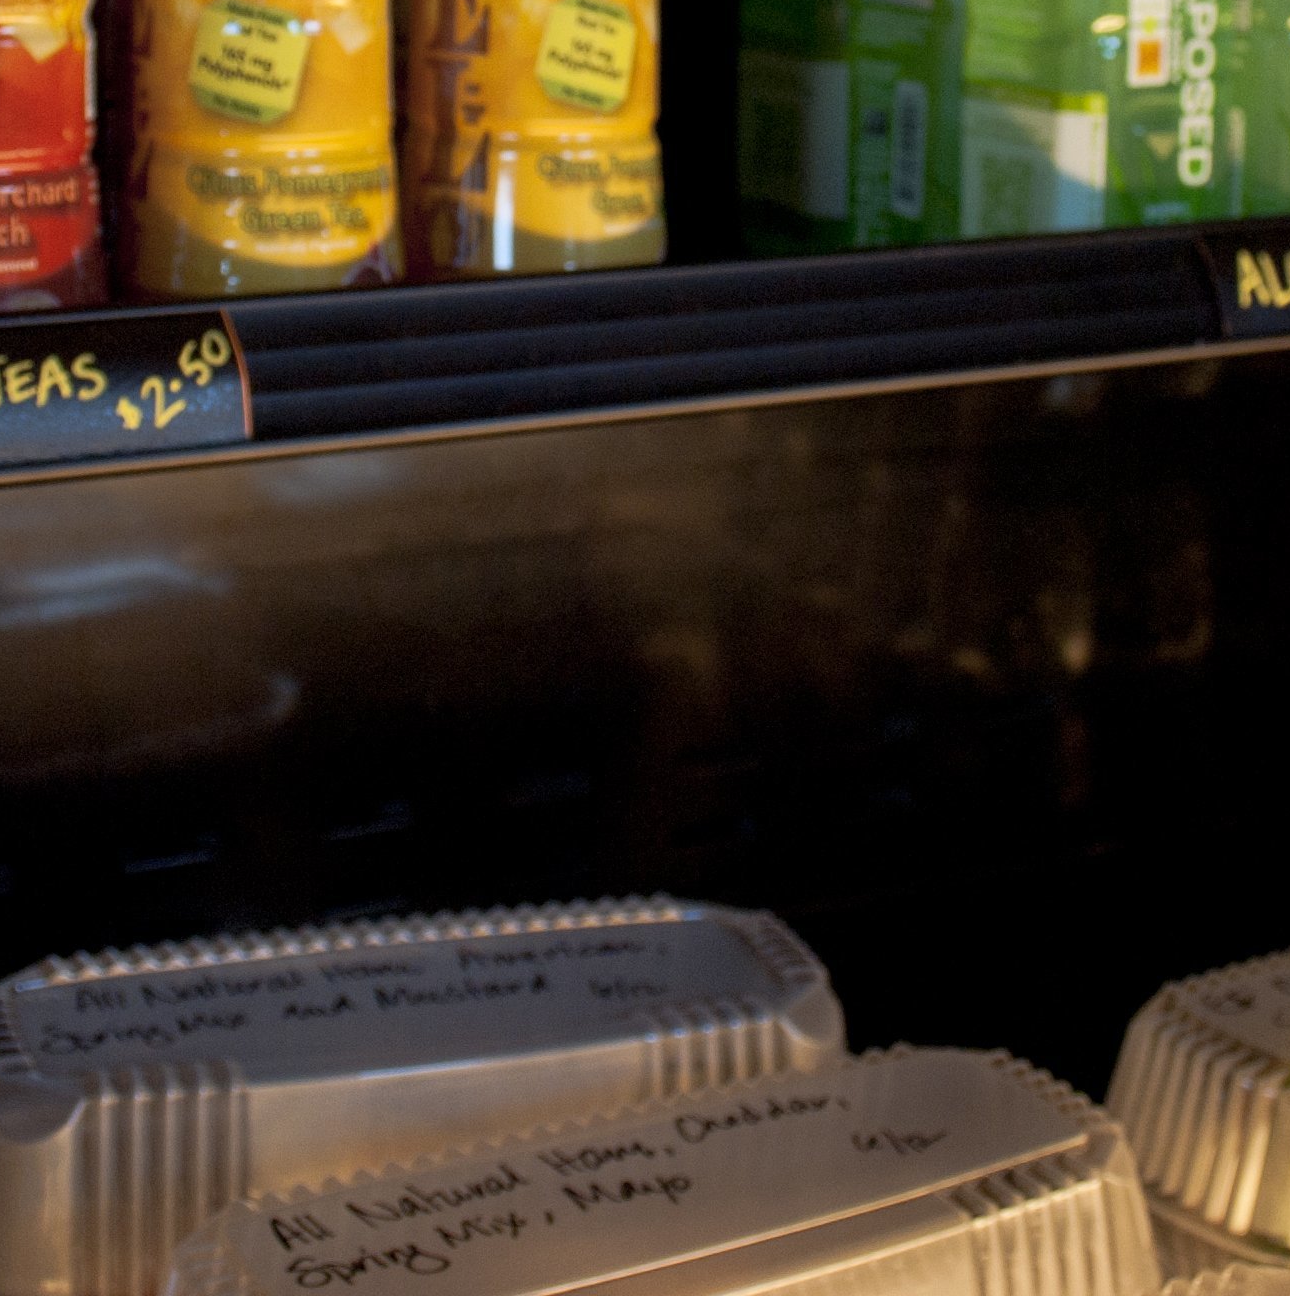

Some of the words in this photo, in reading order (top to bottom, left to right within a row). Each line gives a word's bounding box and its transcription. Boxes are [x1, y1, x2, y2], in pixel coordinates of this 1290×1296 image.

[115, 329, 233, 430] $2.50
[269, 1213, 335, 1252] All
[343, 1162, 533, 1230] Natural
[284, 1242, 453, 1289] Spring
[561, 1173, 693, 1212] Mayo
